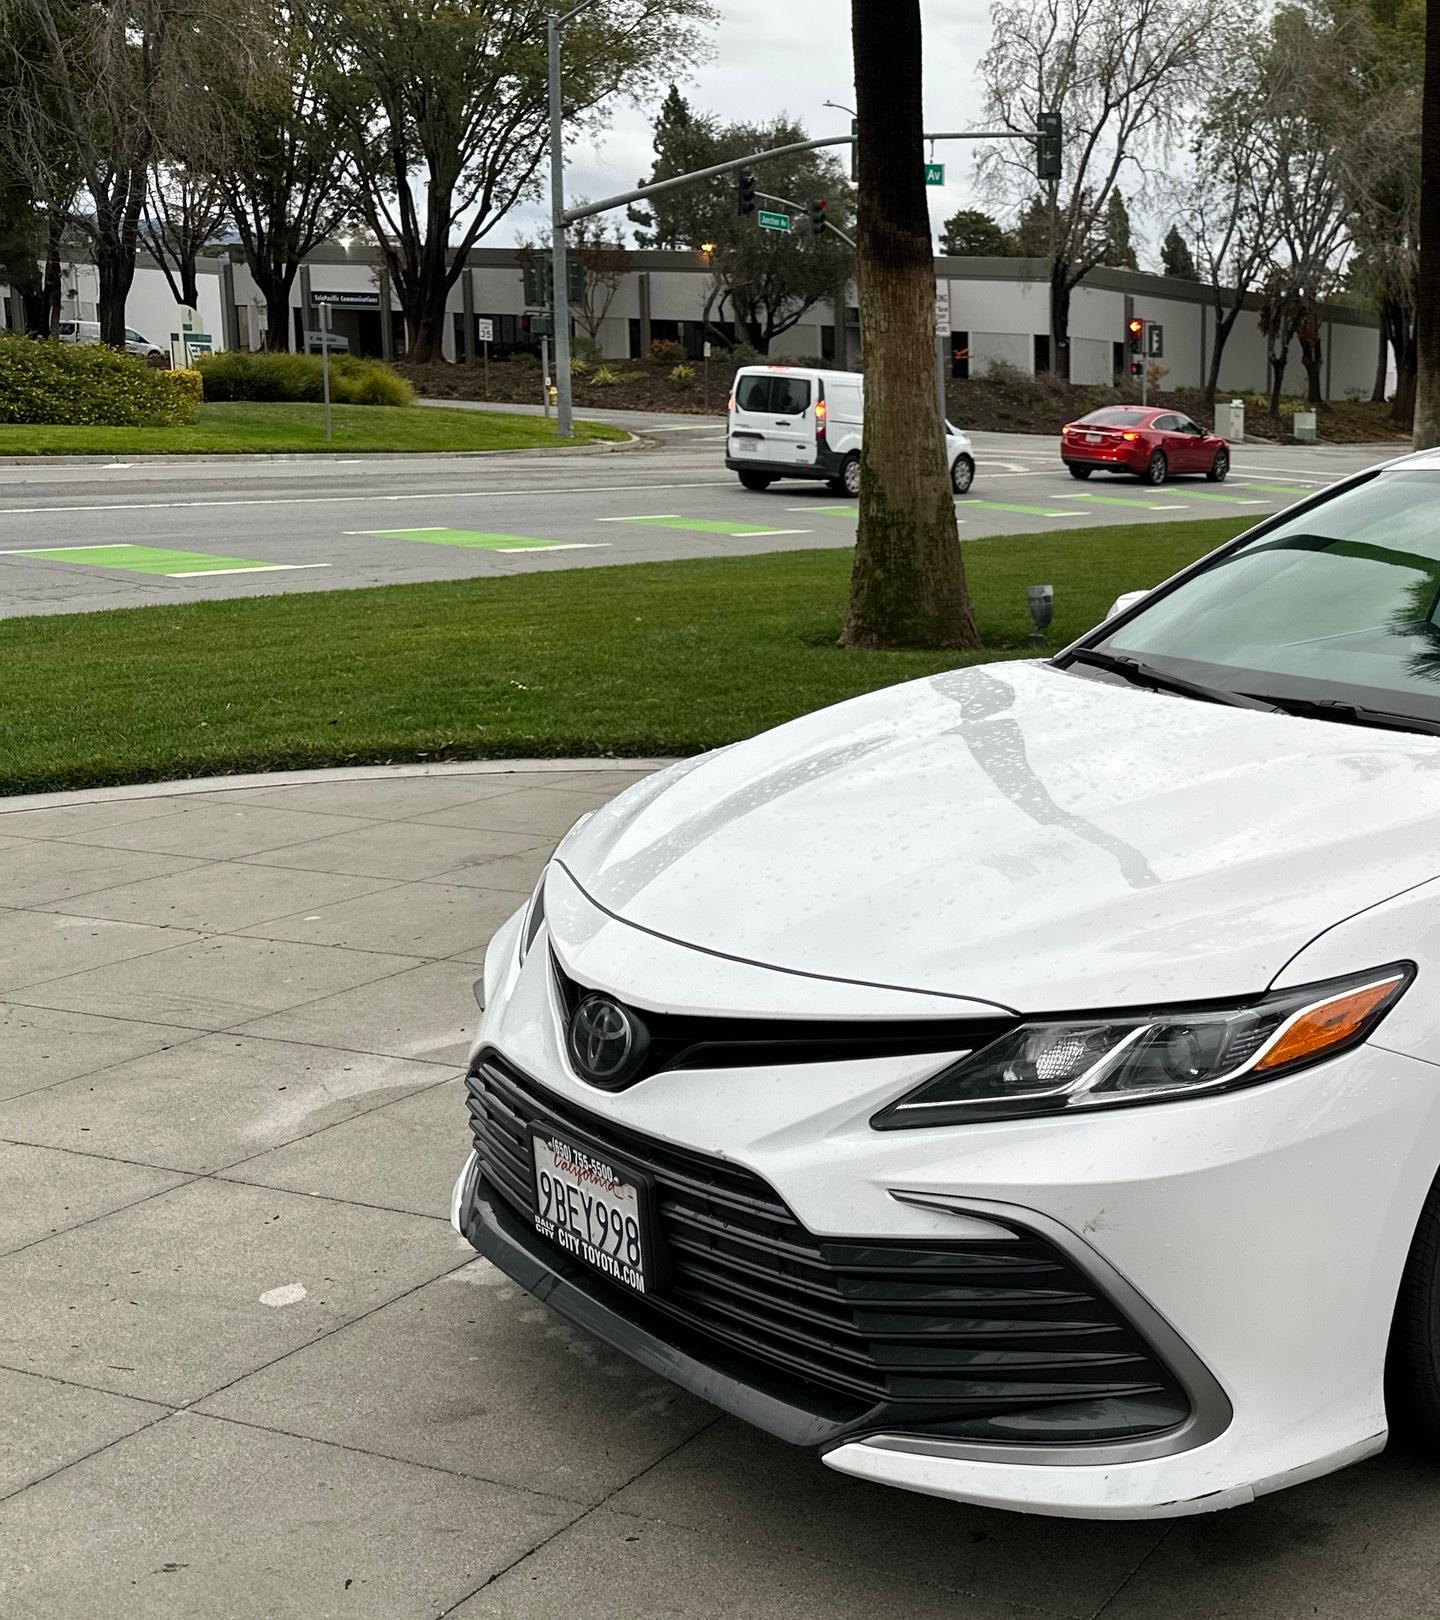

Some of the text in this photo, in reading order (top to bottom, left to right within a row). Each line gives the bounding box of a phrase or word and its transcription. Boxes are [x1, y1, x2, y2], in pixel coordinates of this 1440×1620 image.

[927, 168, 941, 181] Av
[480, 329, 492, 339] 35
[552, 1136, 613, 1183] (650) 755-5500
[534, 1214, 555, 1232] DALY
[540, 1171, 641, 1268] 9BEY998
[535, 1223, 554, 1240] CITY
[558, 1228, 645, 1294] CITY TOYOTA.COM
